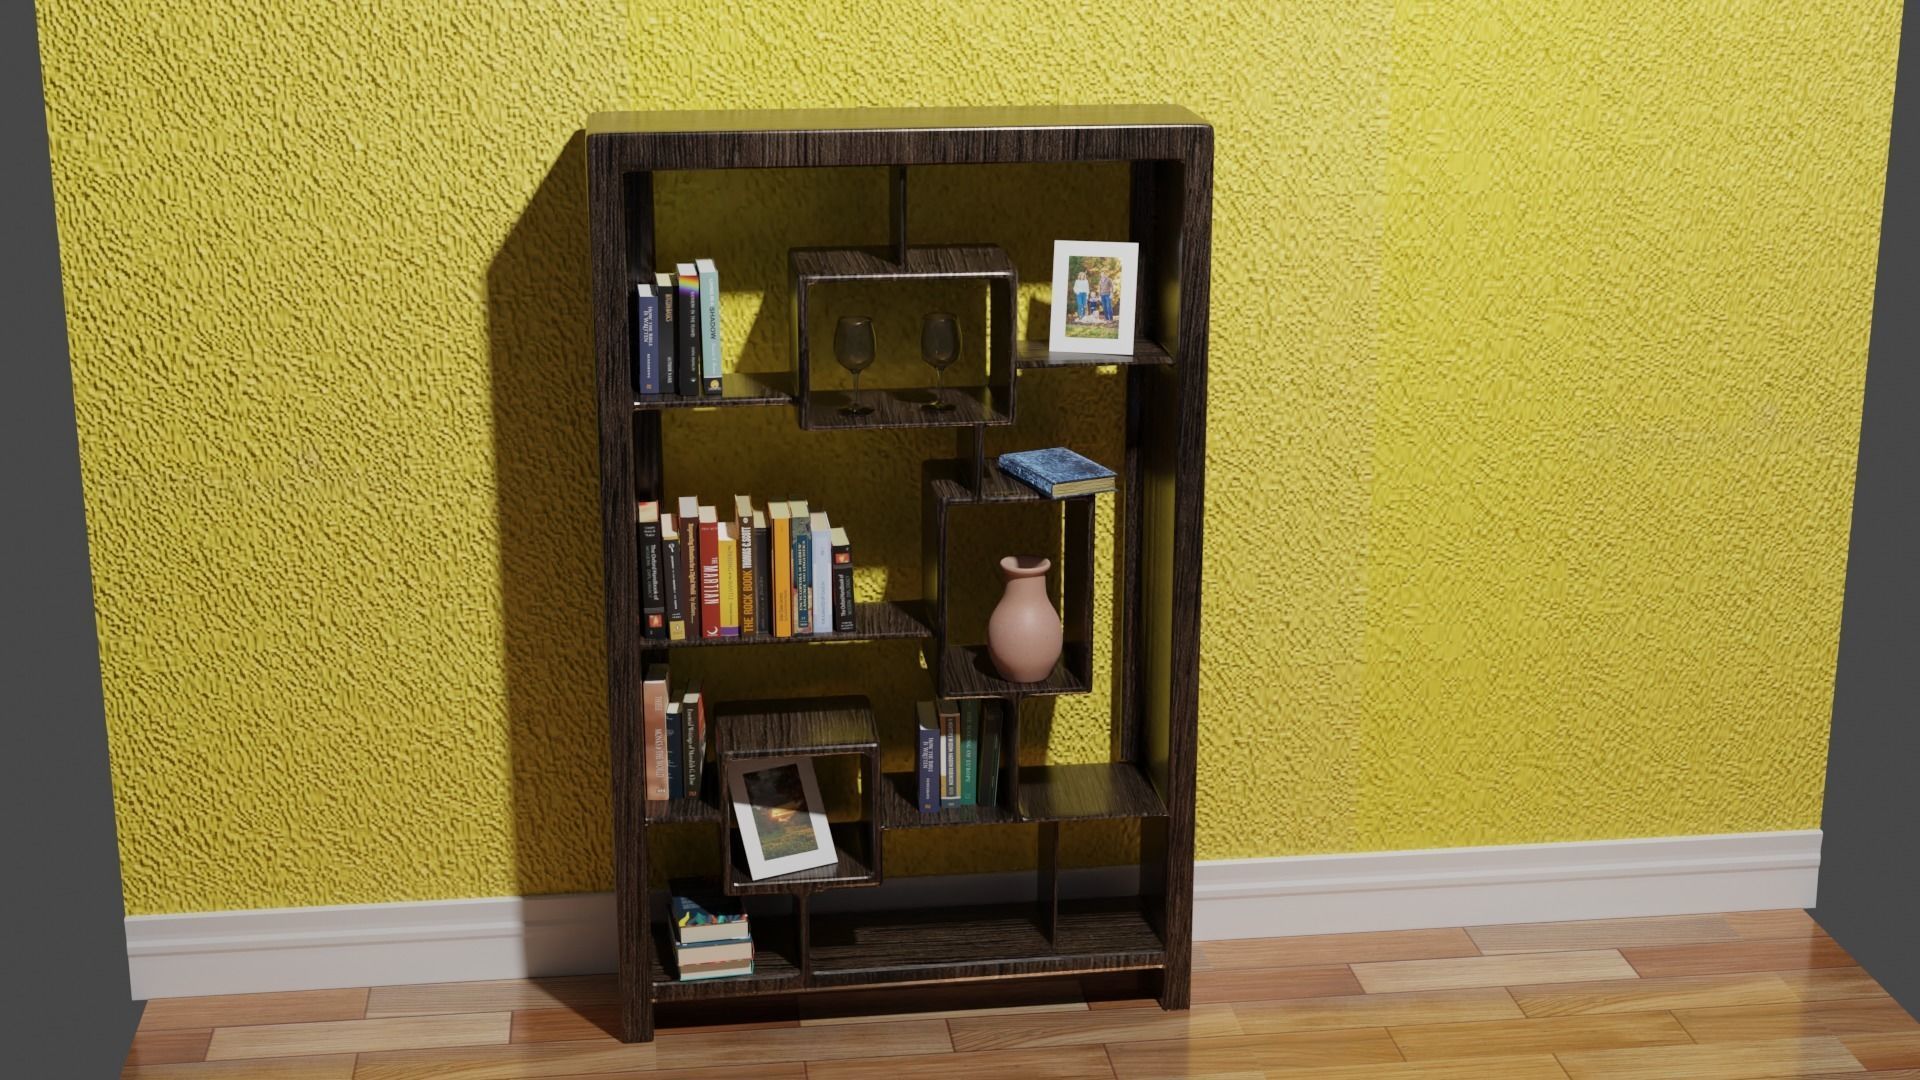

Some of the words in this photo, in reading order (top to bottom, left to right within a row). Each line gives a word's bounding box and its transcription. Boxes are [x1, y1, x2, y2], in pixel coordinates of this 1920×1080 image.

[742, 548, 752, 569] THOMAS
[703, 565, 719, 605] MARTIAN
[743, 571, 753, 591] BOOK
[743, 594, 753, 615] ROCK
[744, 618, 753, 632] THE
